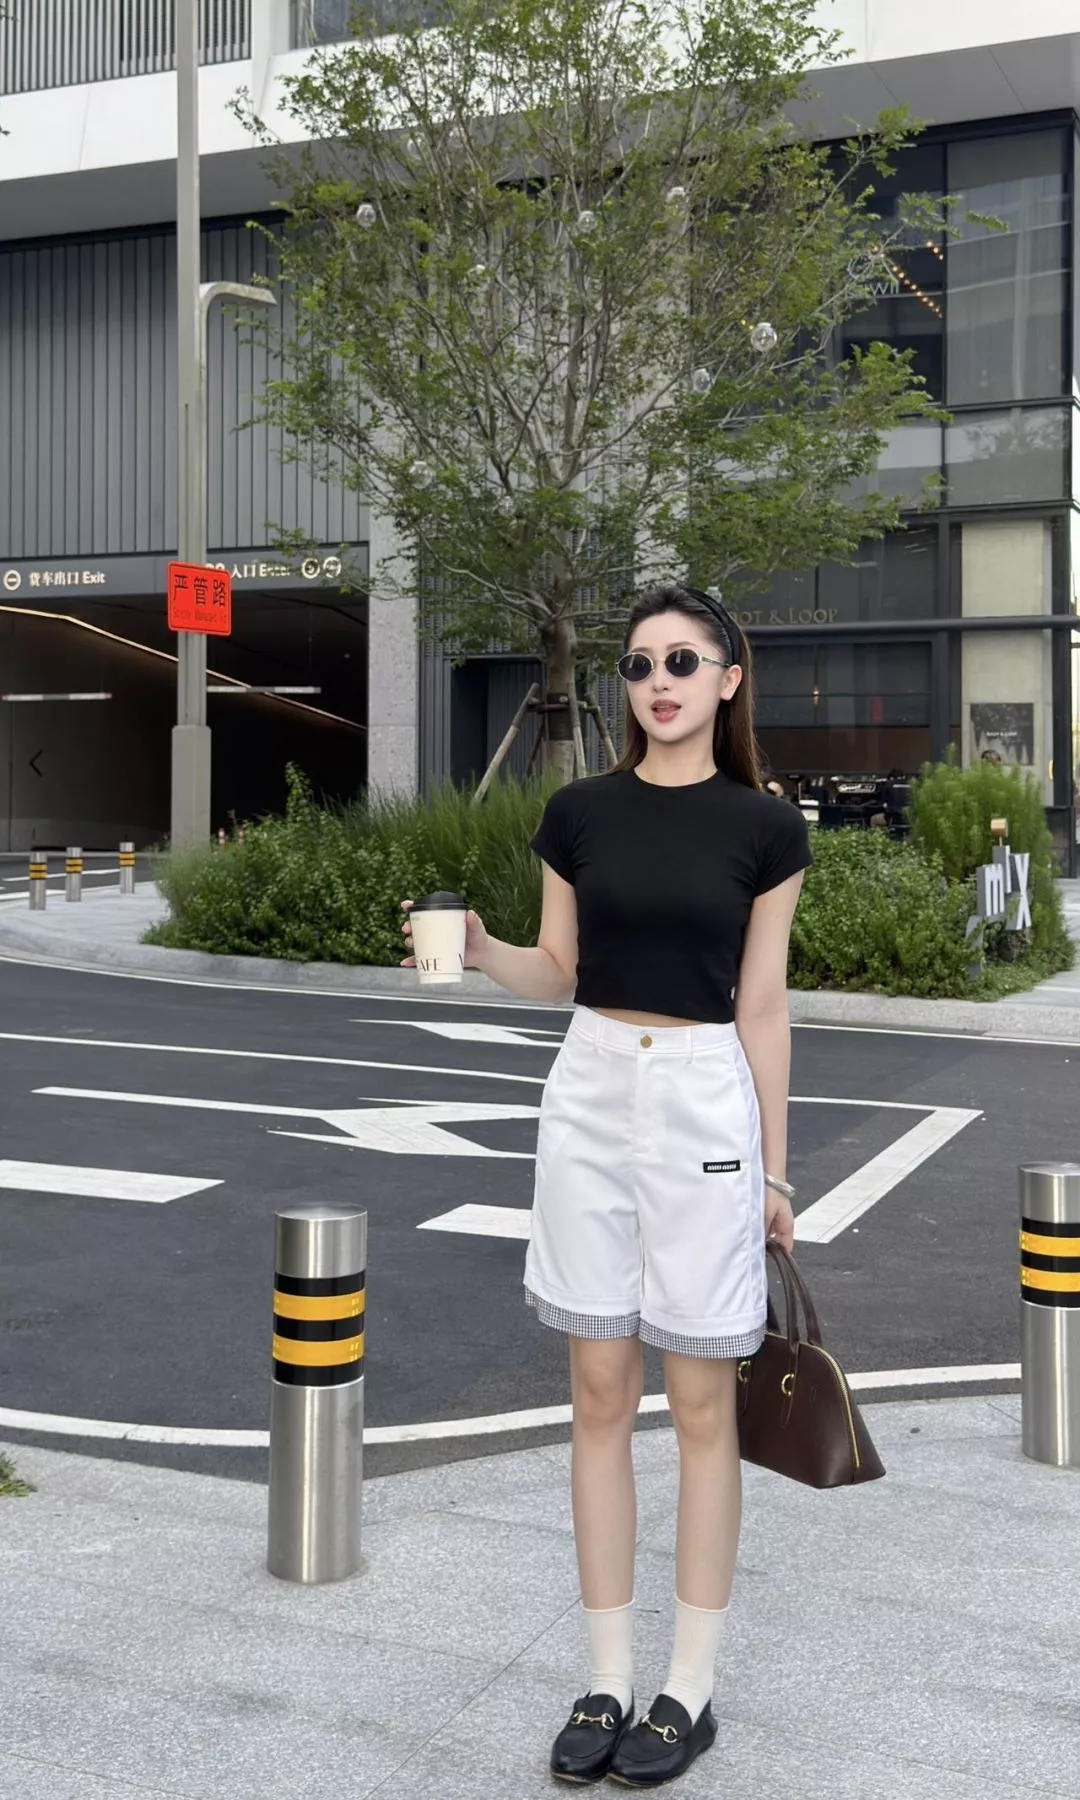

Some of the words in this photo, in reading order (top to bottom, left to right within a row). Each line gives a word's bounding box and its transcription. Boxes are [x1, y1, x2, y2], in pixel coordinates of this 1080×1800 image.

[82, 571, 106, 584] Exit
[173, 574, 226, 607] 严管路
[769, 609, 785, 625] &
[789, 607, 838, 625] LOOP
